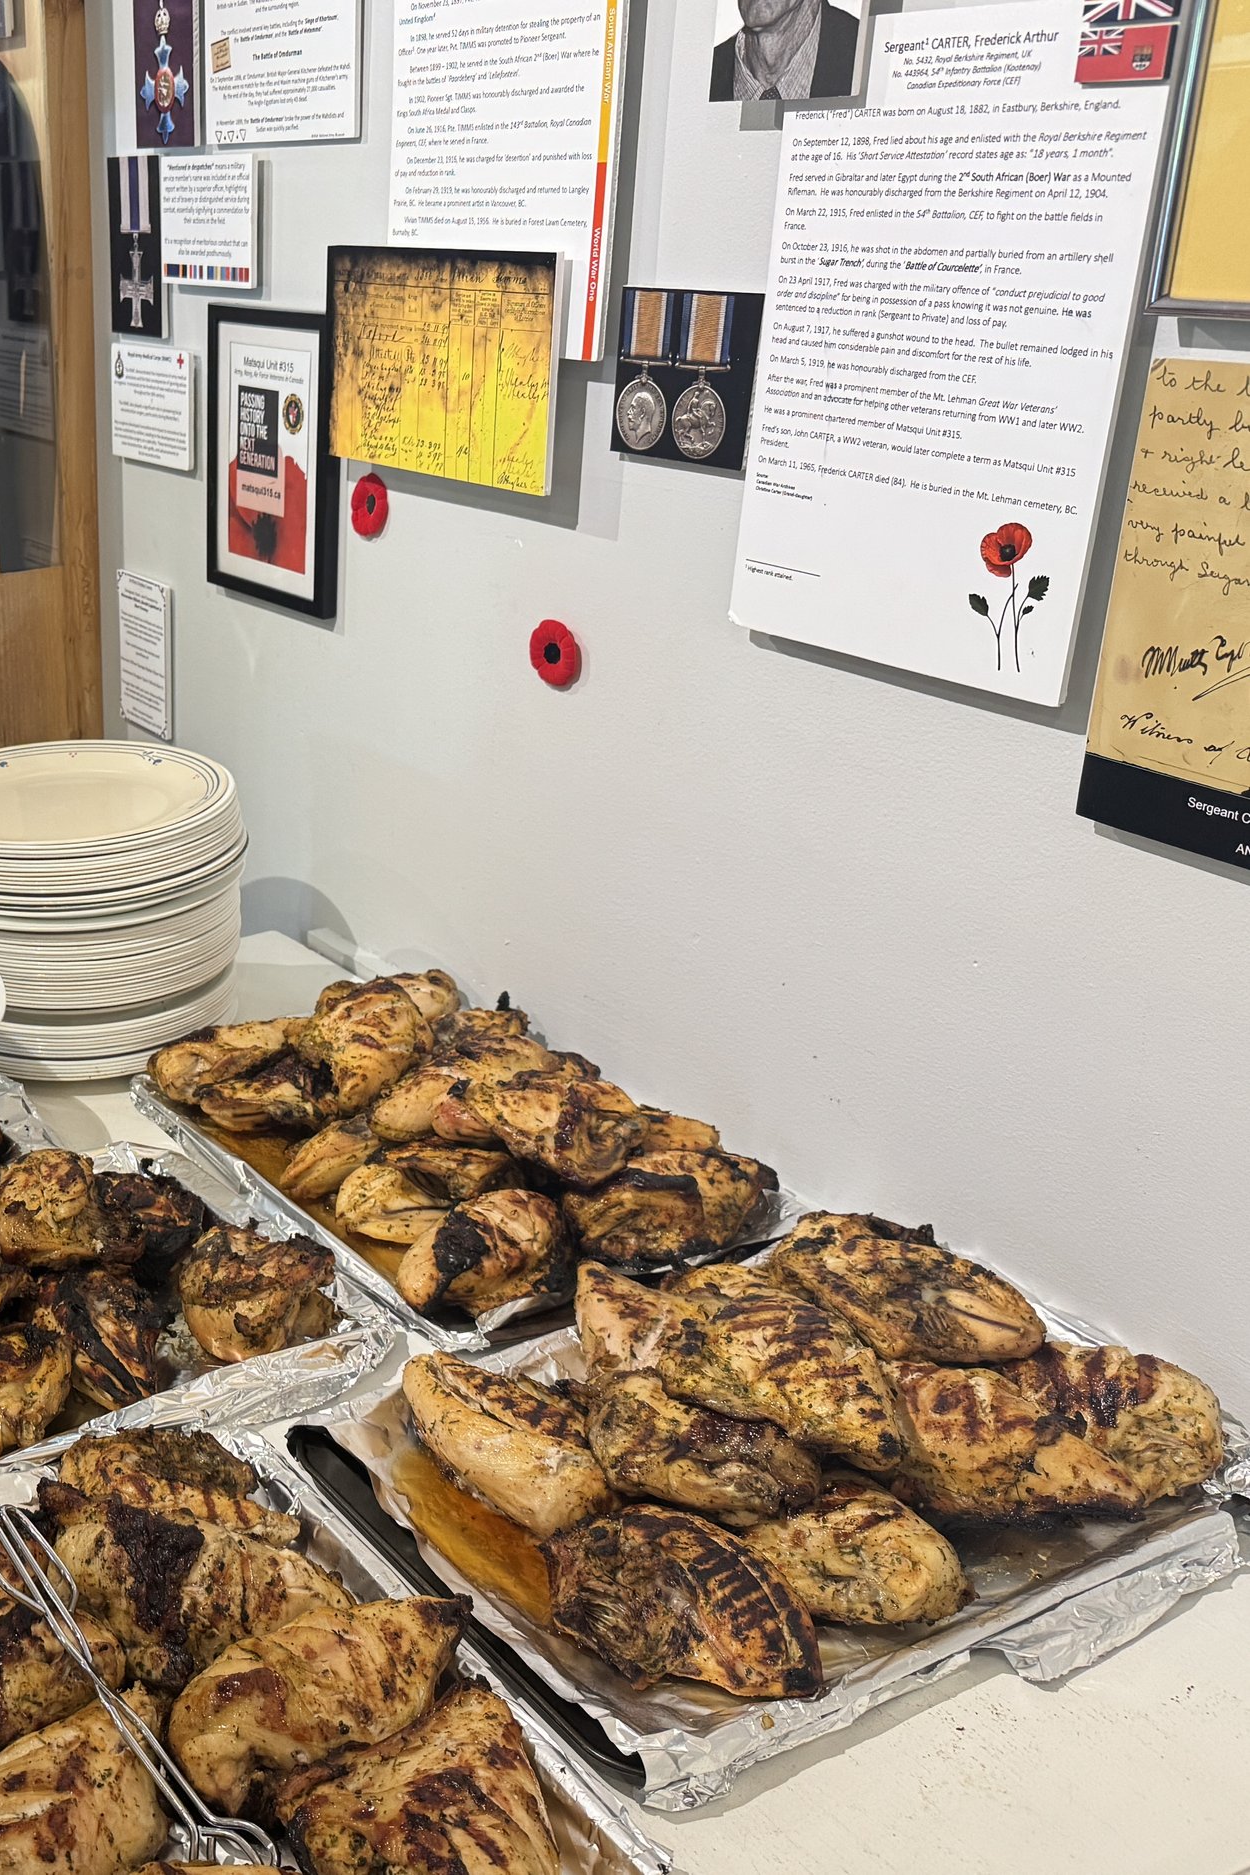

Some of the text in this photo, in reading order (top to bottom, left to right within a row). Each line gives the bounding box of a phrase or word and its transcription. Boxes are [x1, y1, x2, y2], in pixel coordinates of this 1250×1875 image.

[931, 36, 971, 50] CARTER,
[974, 31, 1022, 47] Frederick
[1023, 29, 1059, 44] Arthur
[603, 7, 616, 105] South African War
[915, 56, 933, 65] 5432,
[935, 55, 953, 64] Royal
[954, 53, 984, 62] Berkshire
[985, 51, 1019, 62] Regiment,
[1021, 49, 1033, 58] UK
[892, 70, 902, 78] No.
[945, 66, 971, 77] Infantry
[972, 64, 1002, 74] Battalion
[1003, 61, 1042, 73] (Kootenay)
[907, 76, 1021, 90] Canadian Expeditionary Force (CEF)
[792, 131, 1147, 148] On September 12, 1898, Fred lied about his age and enlisted with the Royal Berkshire Regiment
[588, 227, 601, 302] World War One
[243, 356, 294, 373] Matsqui Unit #315
[1156, 365, 1177, 388] to
[1184, 370, 1226, 393] the
[240, 391, 265, 410] PASSING
[239, 406, 265, 425] HISTORY
[764, 405, 772, 414] He
[791, 411, 824, 420] prominent
[824, 414, 856, 425] chartered
[857, 419, 886, 429] member
[887, 422, 895, 430] of
[896, 423, 924, 435] Matsqui
[926, 427, 941, 436] Unit
[942, 429, 962, 439] #315.
[1149, 405, 1221, 441] partly
[239, 421, 268, 440] ONTO THE
[239, 436, 256, 452] NEXT
[239, 450, 276, 471] GENERATION
[241, 482, 281, 500] matsqui315.ca
[758, 455, 1077, 515] On March 11, 1965, Frederick CARTER died (84). He is buried in the Mt. Lehman cemetery, BC.
[1187, 796, 1240, 821] Sergeant
